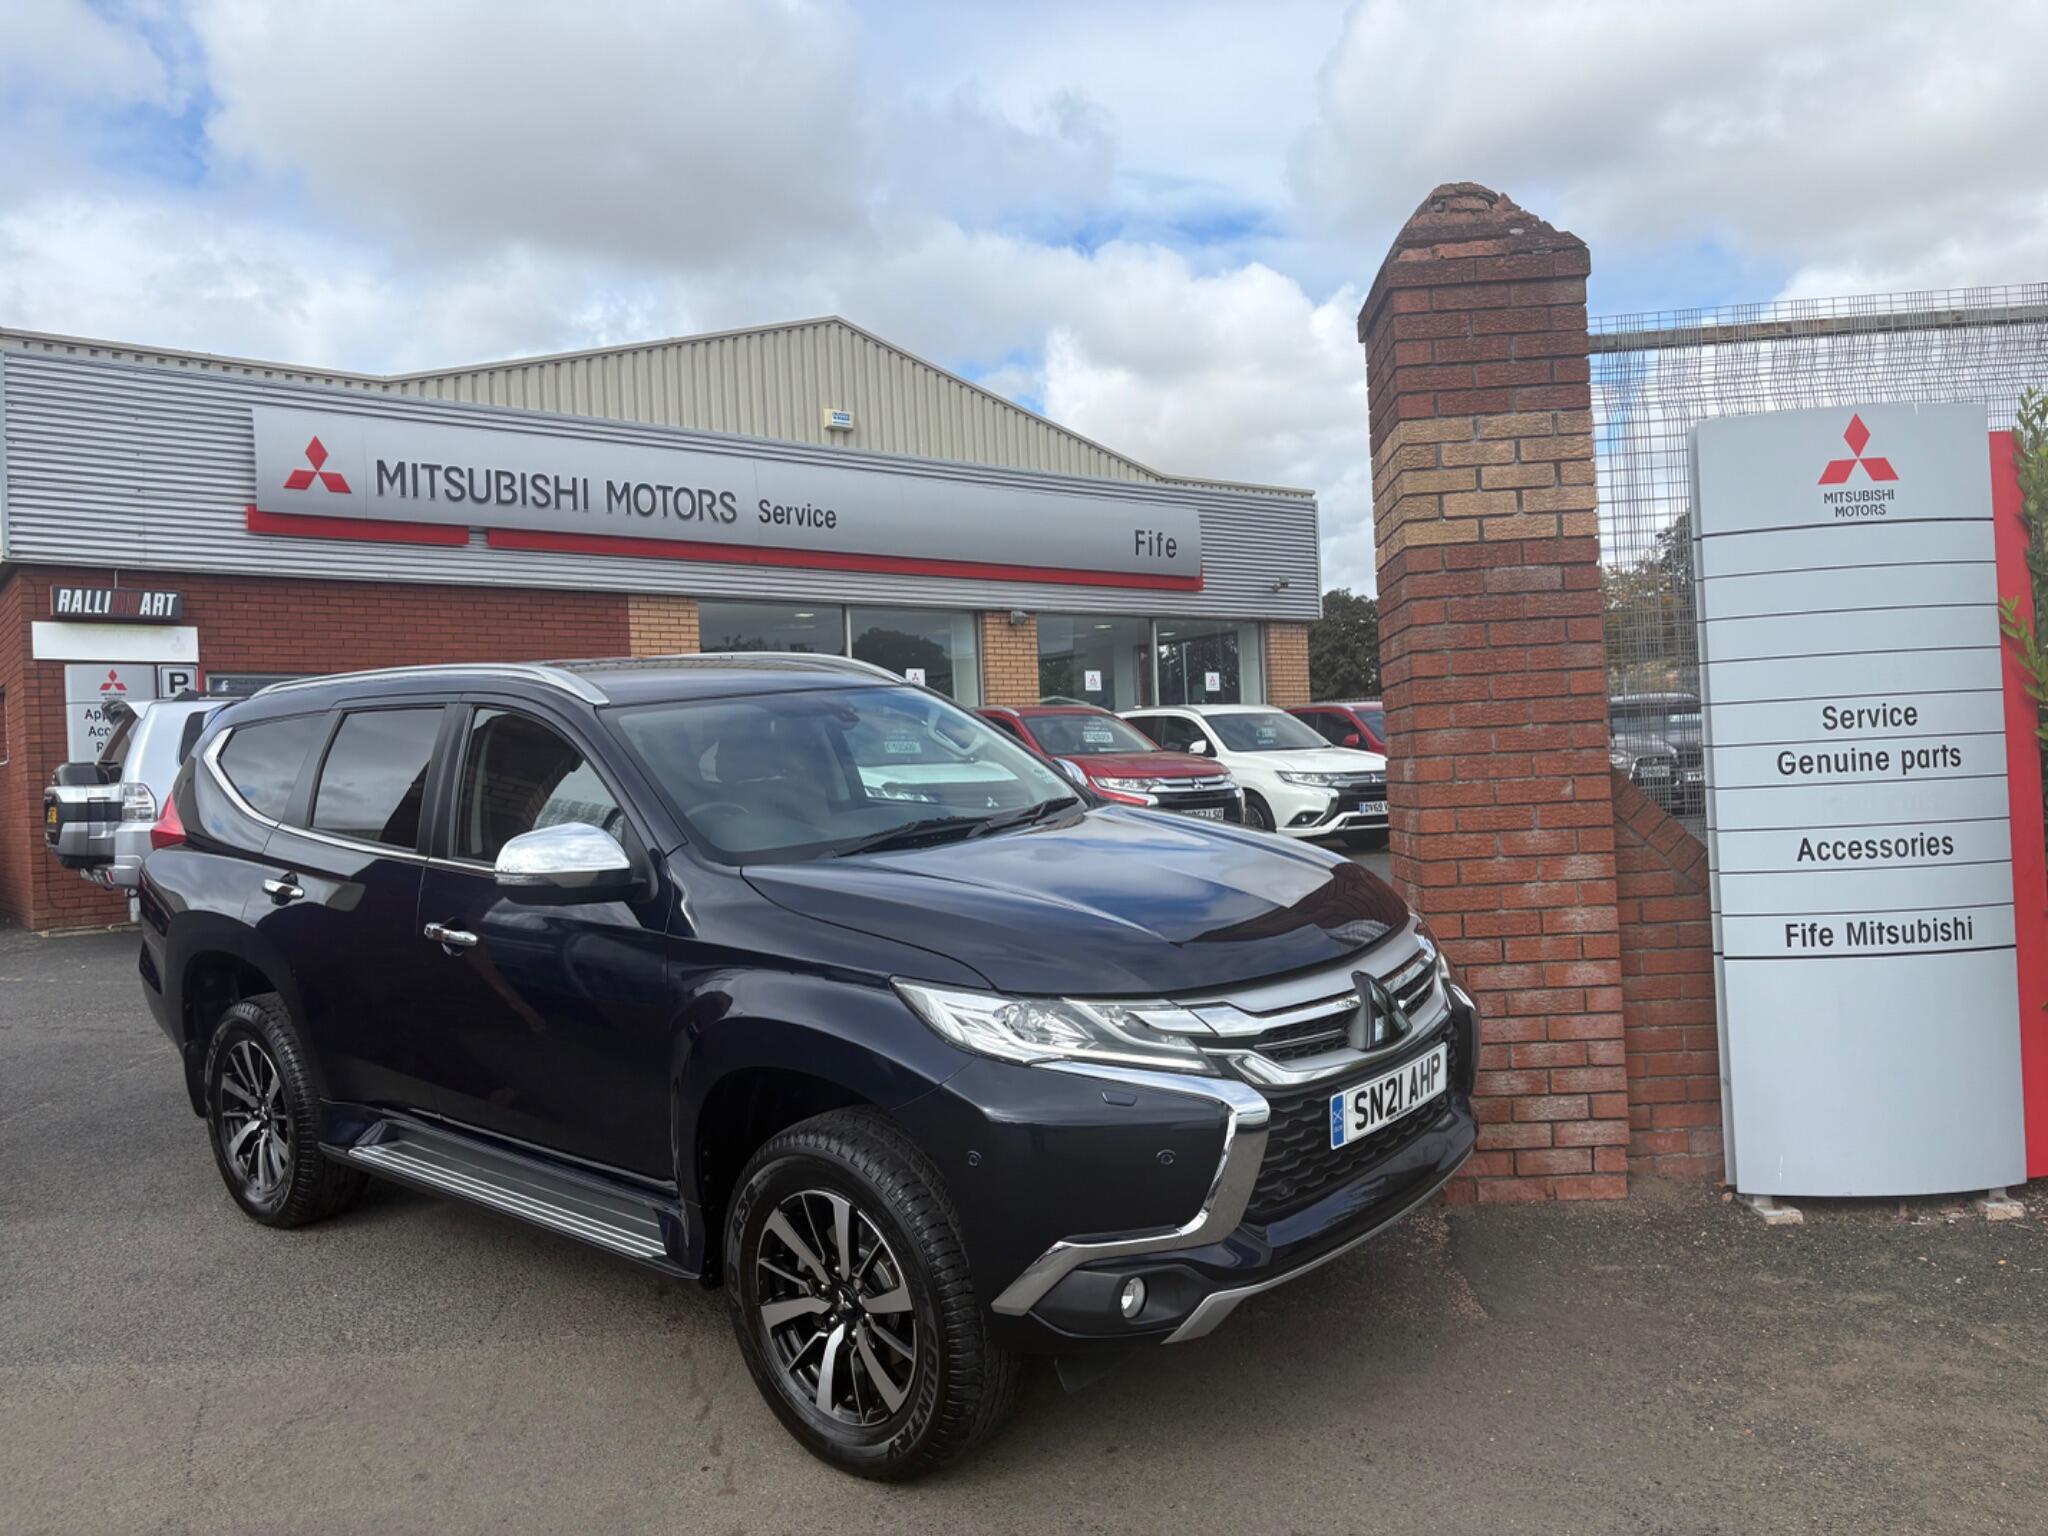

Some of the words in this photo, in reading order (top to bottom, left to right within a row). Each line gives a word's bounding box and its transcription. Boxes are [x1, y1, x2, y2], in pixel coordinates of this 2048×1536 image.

[376, 459, 590, 513] MITSUBISHI
[606, 480, 738, 524] MOTORS
[758, 499, 838, 530] Service
[1823, 489, 1895, 505] MITSUBISHI
[1835, 503, 1887, 518] MOTORS
[1134, 529, 1178, 559] Fife
[169, 672, 189, 694] P
[1822, 702, 1919, 732] Service
[1777, 750, 1890, 776] Genuine
[1901, 745, 1962, 776] parts
[1797, 831, 1955, 863] Accessories
[1785, 921, 1834, 948] Fife
[1847, 915, 1974, 946] Mitsubishi
[1354, 1073, 1403, 1131] SN21
[1408, 1052, 1441, 1105] AHP
